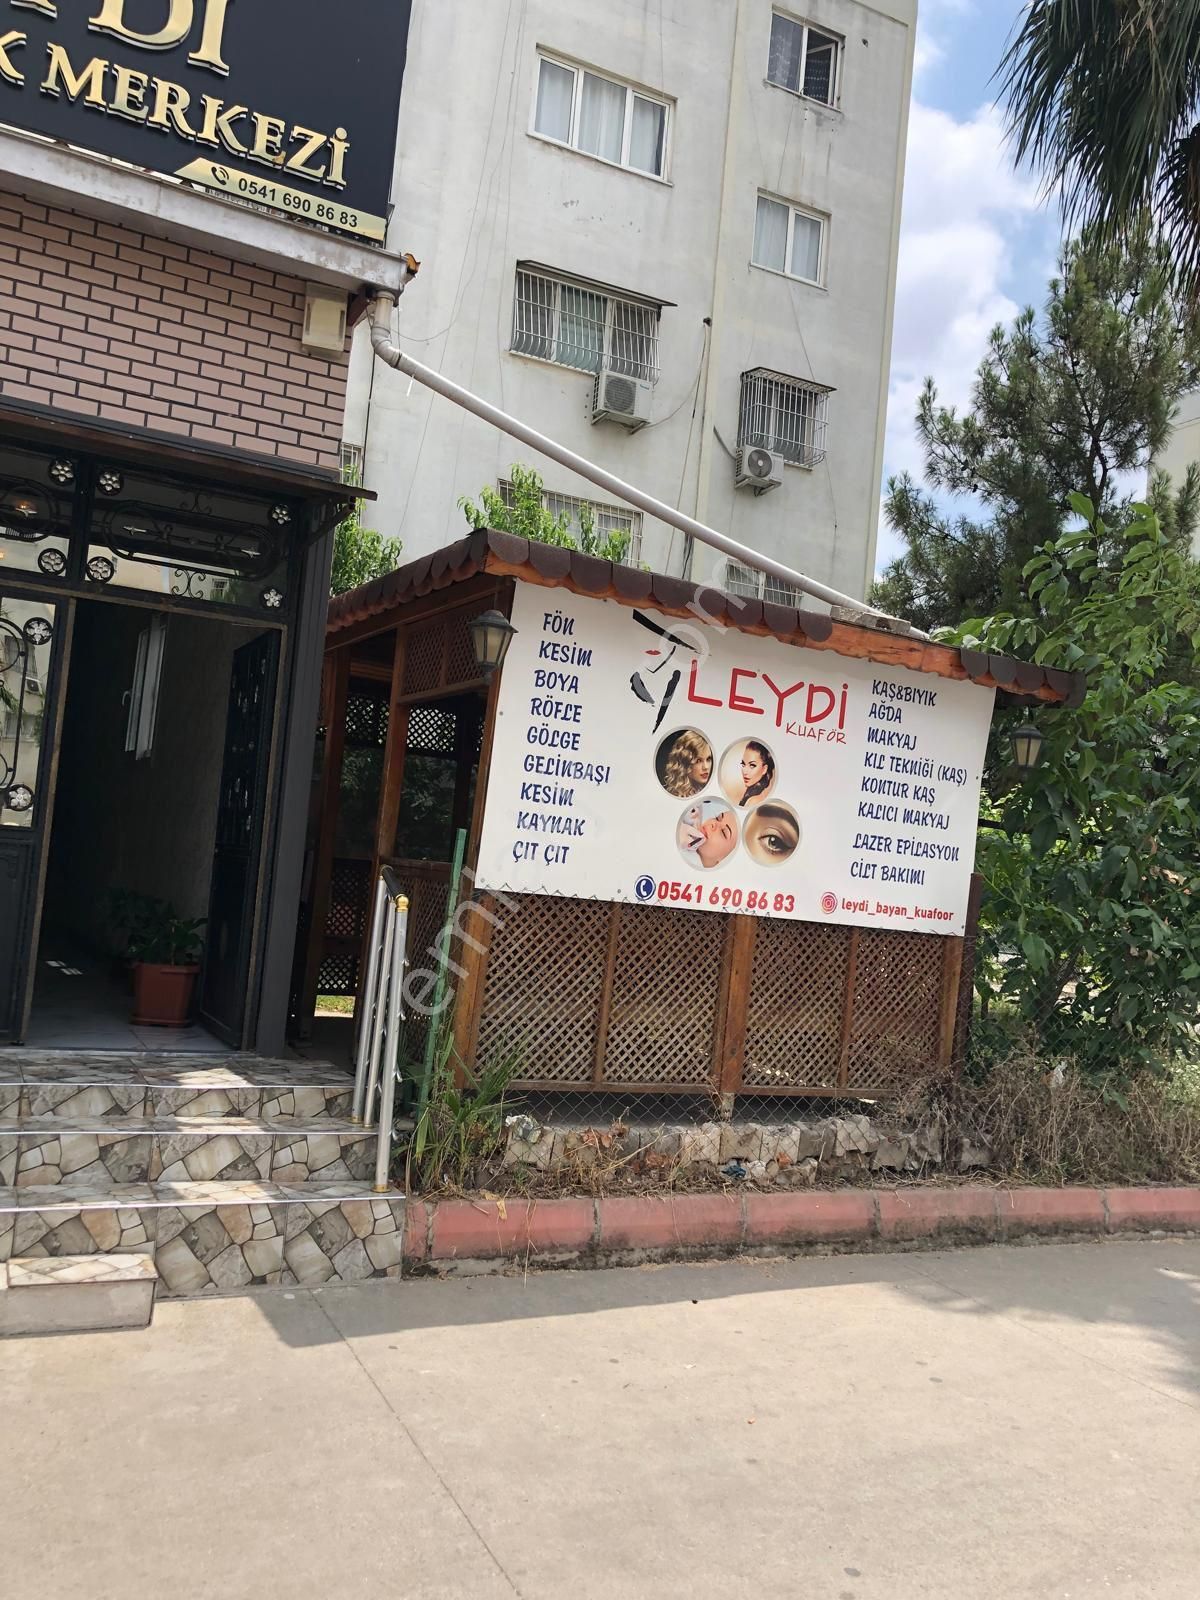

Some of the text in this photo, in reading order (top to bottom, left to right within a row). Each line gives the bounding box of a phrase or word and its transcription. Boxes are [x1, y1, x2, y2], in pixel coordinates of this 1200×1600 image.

[40, 42, 352, 191] MERKEZİ
[238, 178, 358, 228] 0541 690 86 83
[542, 610, 574, 636] FÖN
[538, 640, 593, 667] KESİM
[534, 669, 579, 694] BOYA
[687, 659, 849, 730] LEYDİ
[872, 679, 938, 707] KAŞ&BIYIK
[530, 695, 582, 723] RÖFLE
[868, 700, 902, 724] AĞDA
[527, 723, 581, 751] GÖLGE
[785, 722, 847, 745] KUAFÖR
[867, 726, 917, 751] MAKYAJ
[523, 753, 611, 787] GELİNBAŞI
[864, 751, 967, 787] KIL TEKNİĞİ (KAŞ)
[520, 781, 574, 807] KESİM
[861, 776, 935, 807] KONTUR KAŞ
[516, 811, 586, 836] KAYNAK
[858, 801, 950, 830] KALICI MAKYAJ
[512, 840, 570, 867] ÇIT ÇIT
[853, 833, 960, 862] LAZER EPİLASYON
[850, 858, 925, 886] CİLT BAKIMI
[657, 881, 795, 913] 0541 690 86 83
[842, 897, 955, 922] leydi_bayan_kuafoor
